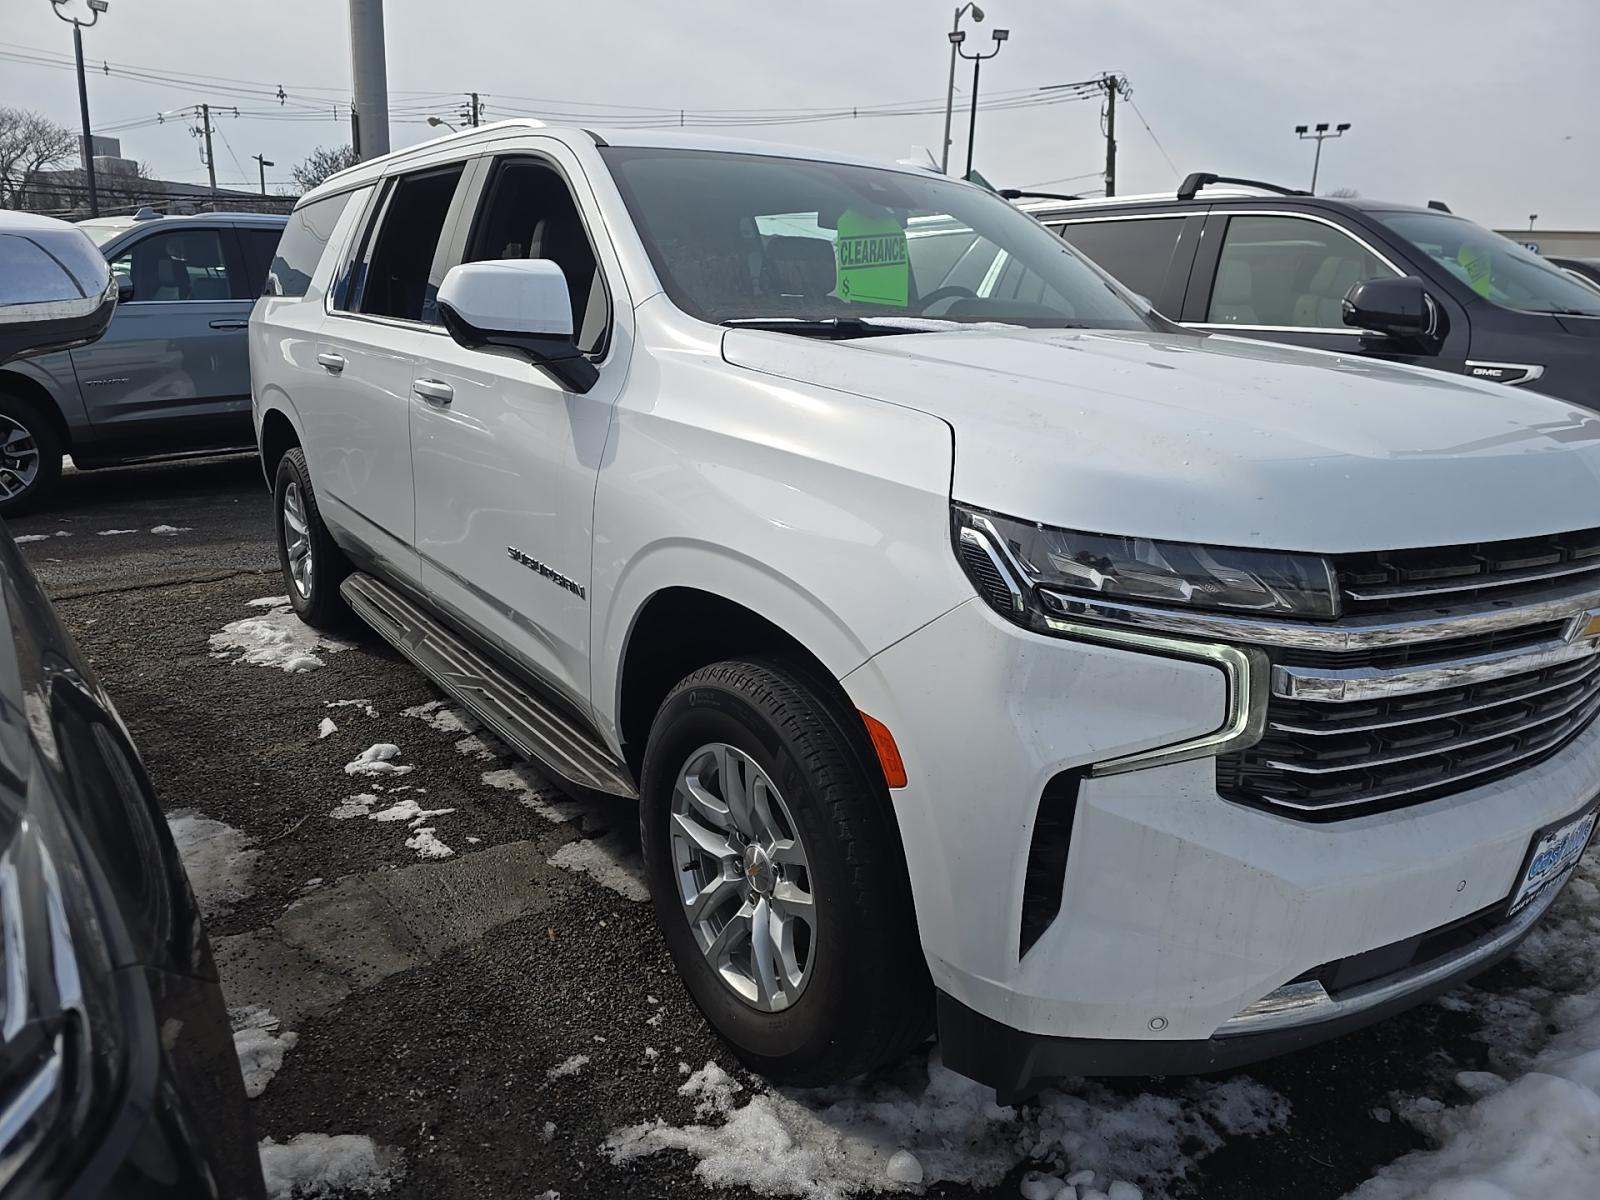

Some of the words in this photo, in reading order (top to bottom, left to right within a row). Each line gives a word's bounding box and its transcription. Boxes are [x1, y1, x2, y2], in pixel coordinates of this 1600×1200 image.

[840, 237, 906, 266] CLEARANCE
[1473, 368, 1503, 377] GMC
[507, 545, 586, 601] SUBURBAN
